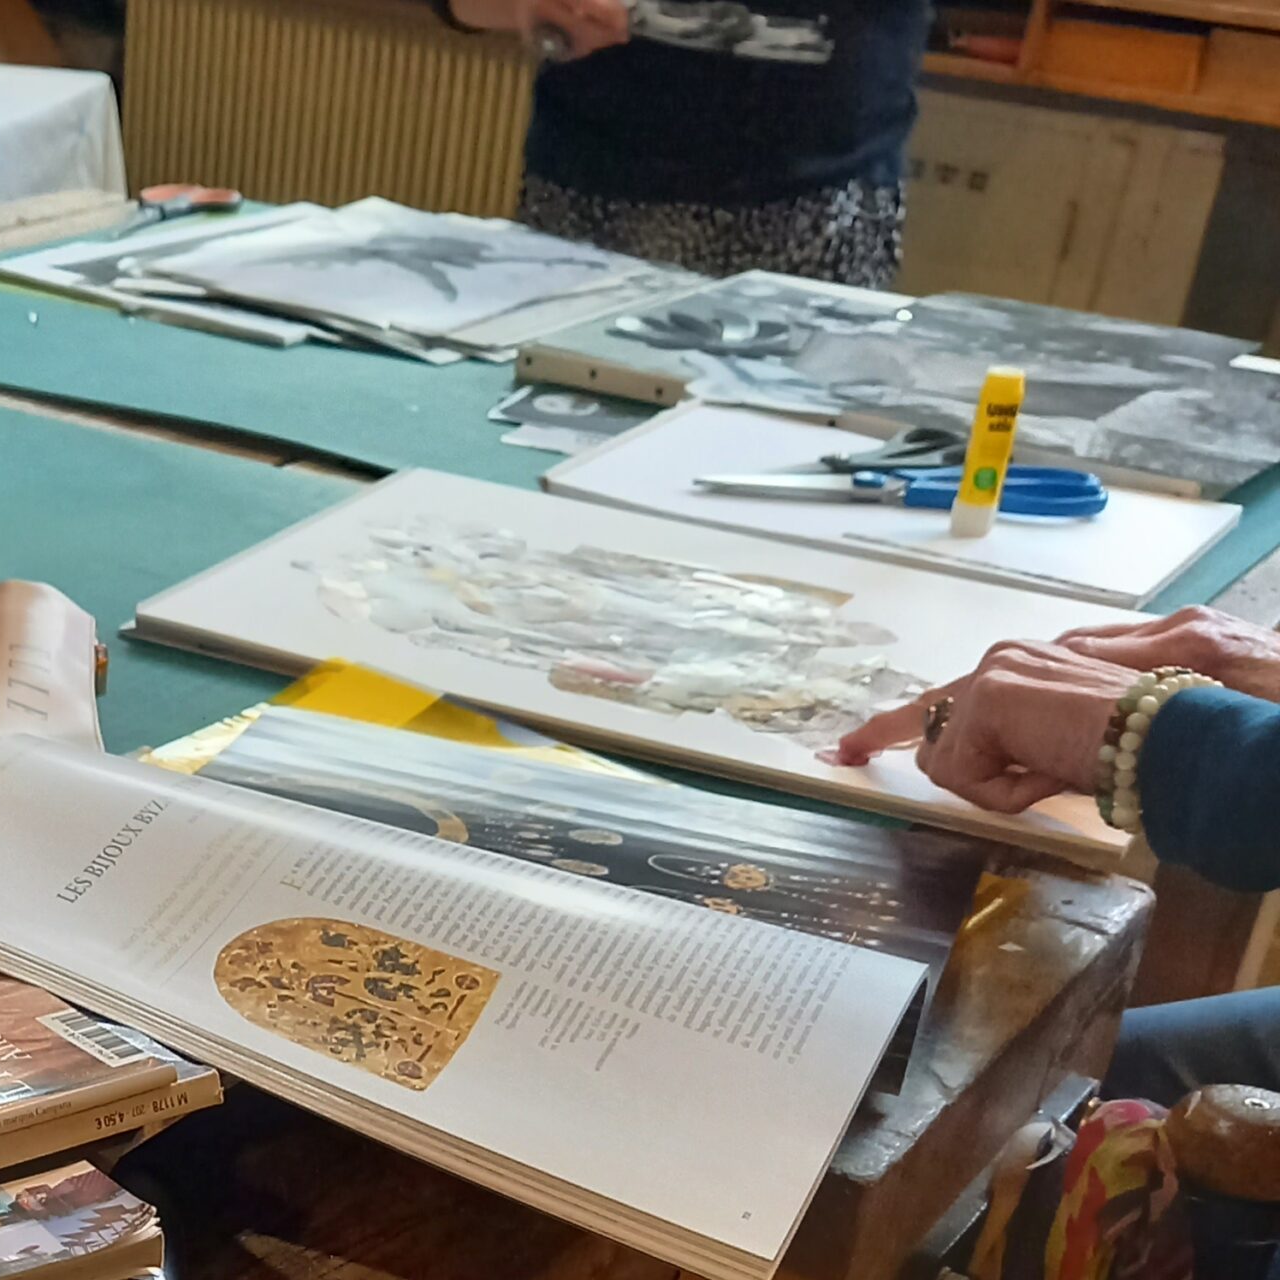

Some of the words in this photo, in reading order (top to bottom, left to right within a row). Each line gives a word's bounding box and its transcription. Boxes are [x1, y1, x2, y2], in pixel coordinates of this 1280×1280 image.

[56, 876, 92, 903] LES
[83, 824, 142, 877] BIJOUX
[152, 1096, 175, 1114] 1178
